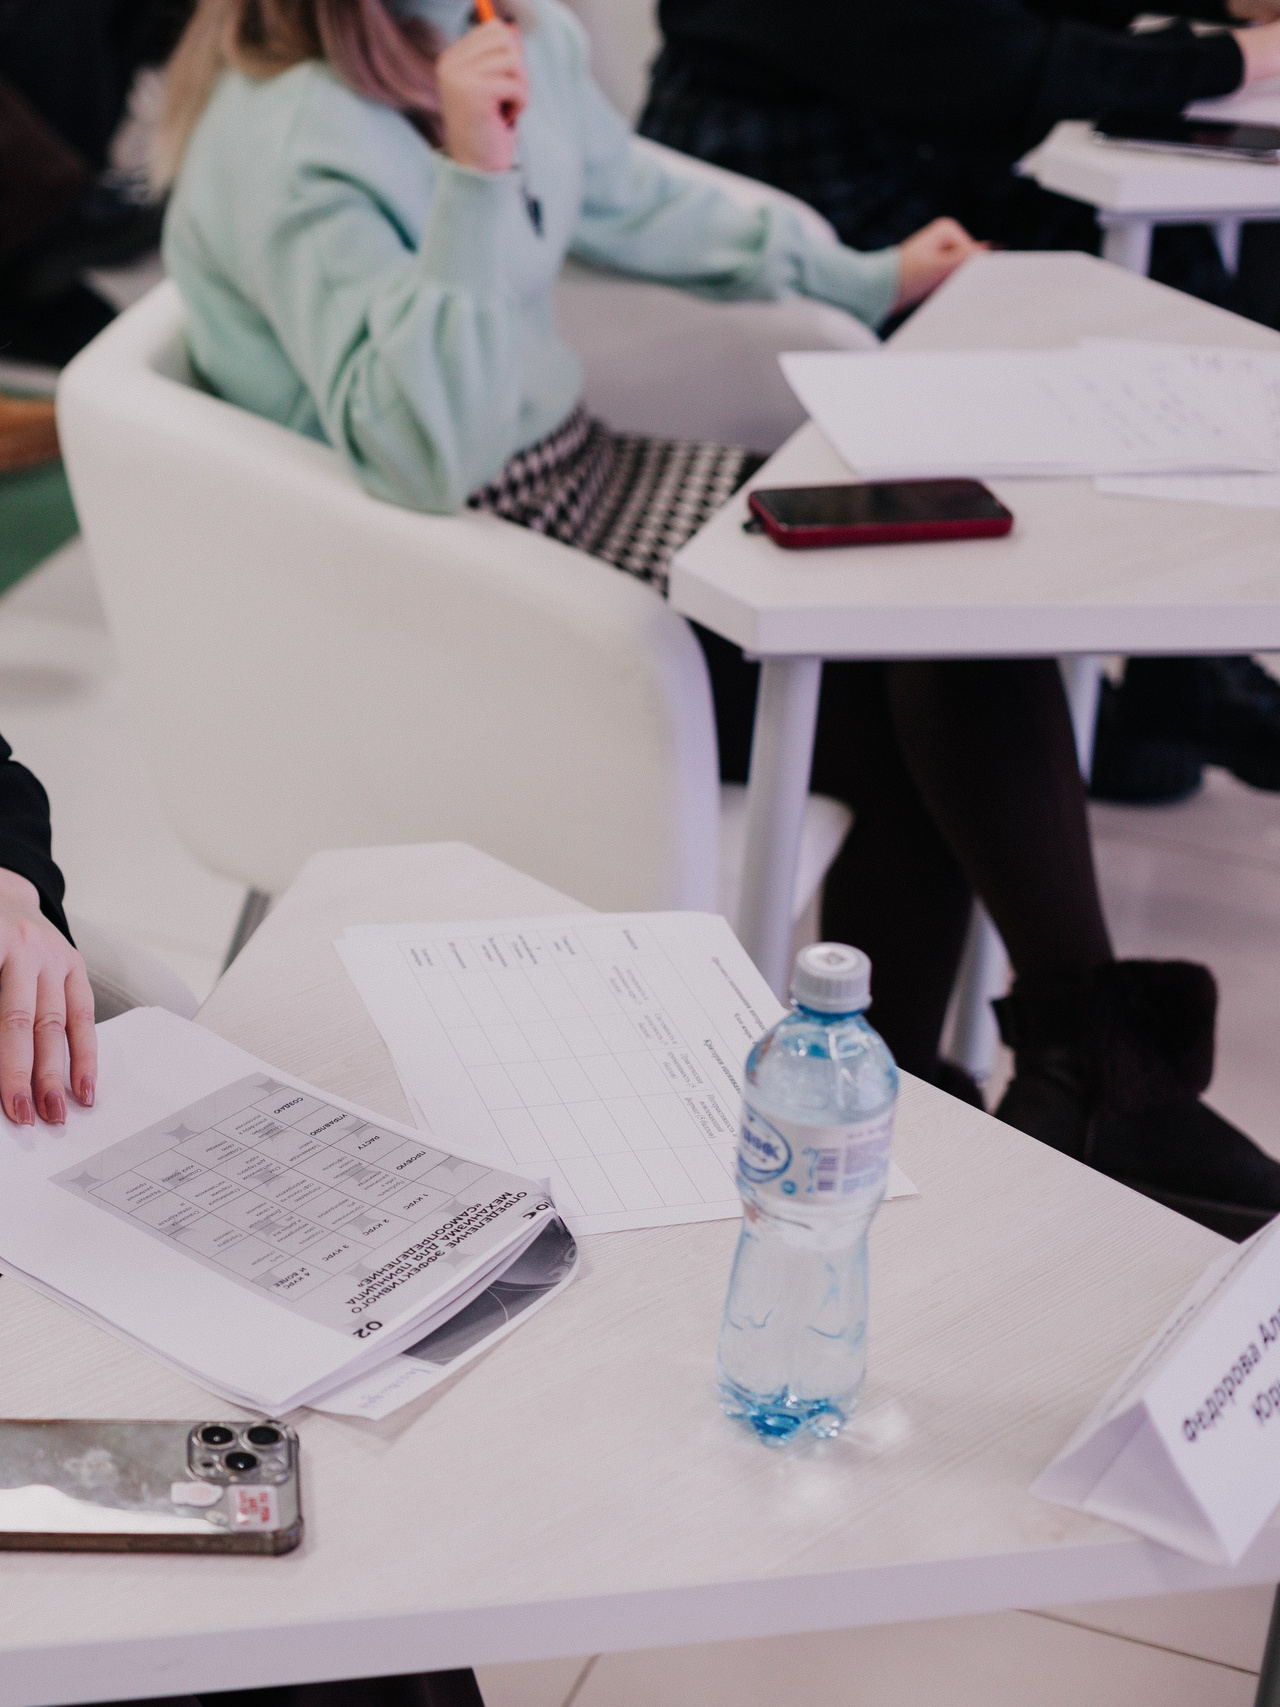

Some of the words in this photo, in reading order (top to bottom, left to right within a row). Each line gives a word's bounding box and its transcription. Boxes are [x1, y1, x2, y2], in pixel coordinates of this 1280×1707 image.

[699, 1039, 727, 1064] Критерии
[678, 1053, 706, 1083] Практическая
[271, 1096, 305, 1114] СОЗДАЮ
[697, 1101, 725, 1132] вовлекающий
[704, 1094, 738, 1132] Интерактивность
[308, 1113, 348, 1136] УПРАВЛЯЮ
[355, 1135, 381, 1150] РАСТУ
[394, 1150, 427, 1171] ПРОБУЮ
[439, 1191, 513, 1242] МЕХАНИЗМА
[444, 1190, 529, 1249] ОПРЕДЕЛЕНИЕ
[355, 1201, 483, 1288] «САМООПРЕДЕЛЕНИЕ»
[411, 1242, 440, 1261] ДЛЯ
[272, 1271, 299, 1288] БОЛЕЕ
[344, 1261, 412, 1306] ПРИНЦИПА
[348, 1249, 446, 1314] ЭФФЕКТИВНОГО
[352, 1318, 384, 1339] 02
[1182, 1342, 1261, 1443] Федорова
[1259, 1308, 1280, 1347] Ал
[1250, 1377, 1280, 1425] Юр
